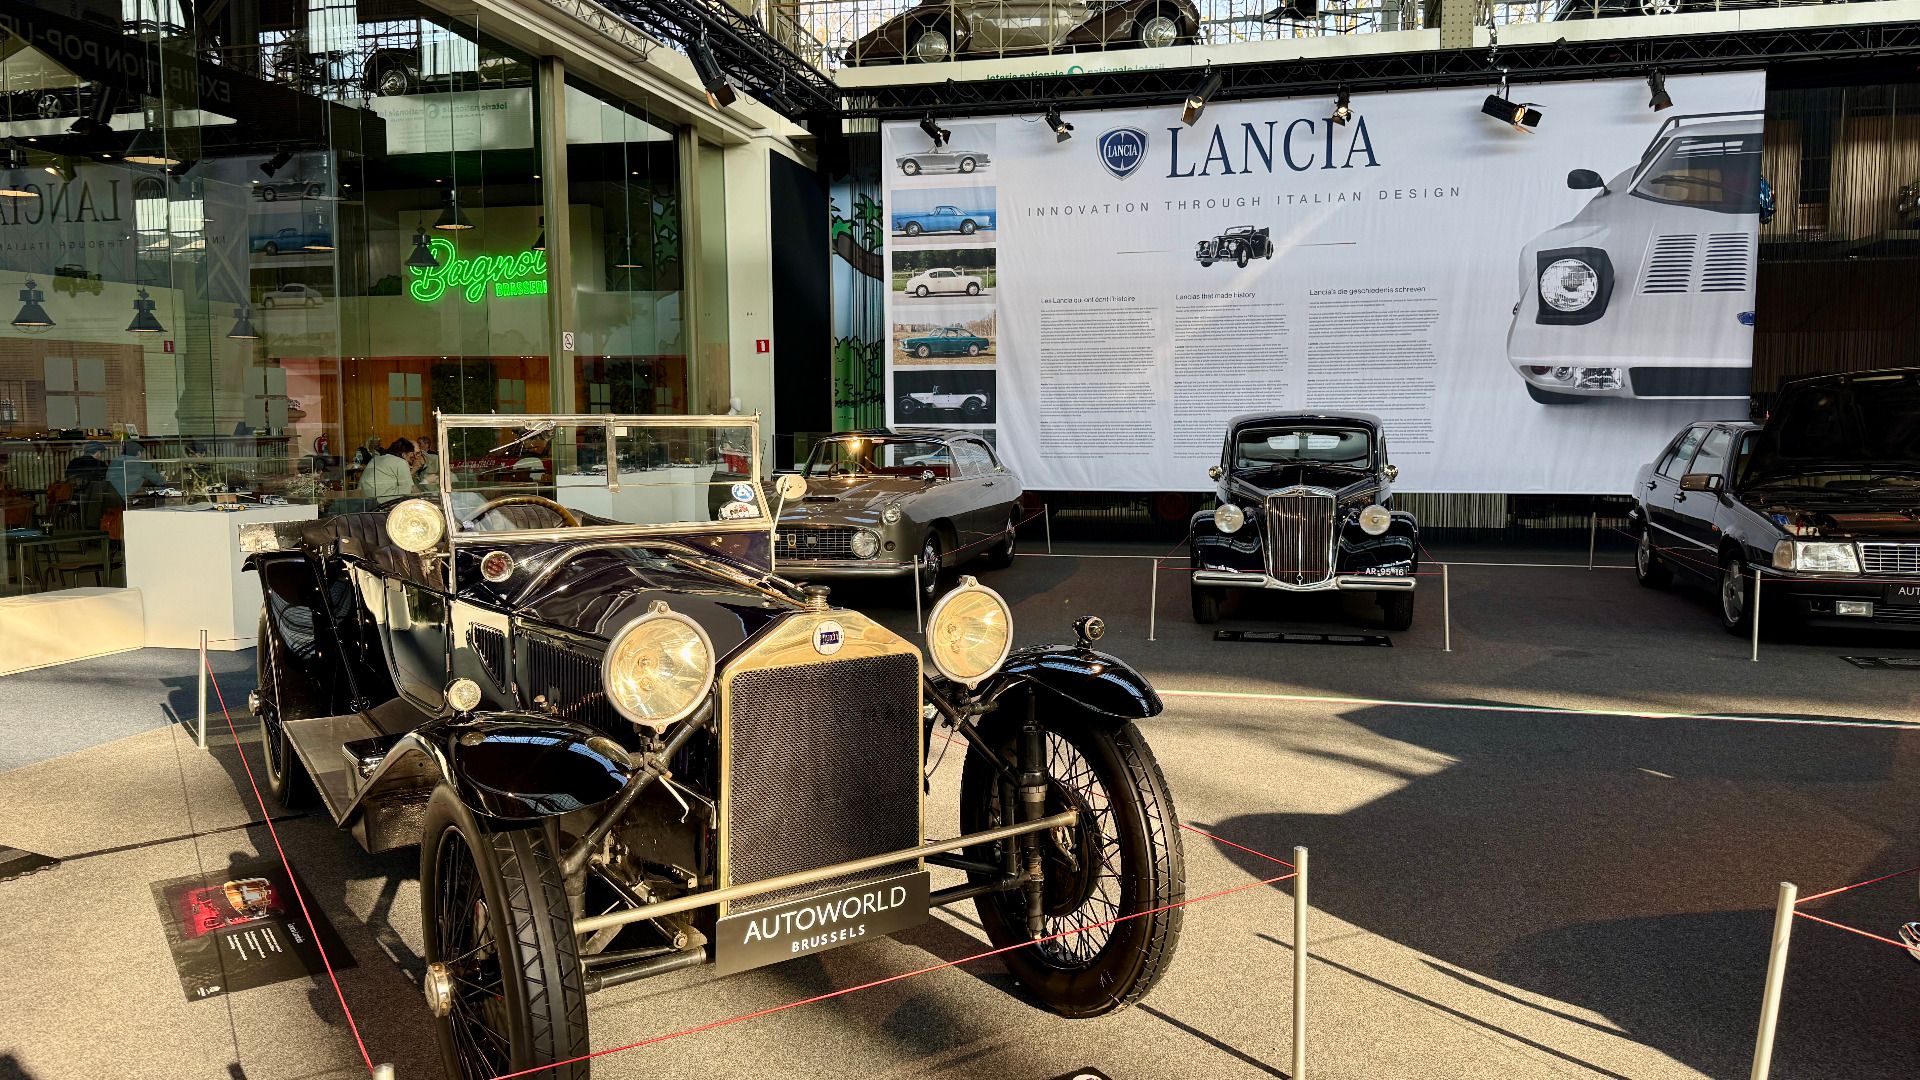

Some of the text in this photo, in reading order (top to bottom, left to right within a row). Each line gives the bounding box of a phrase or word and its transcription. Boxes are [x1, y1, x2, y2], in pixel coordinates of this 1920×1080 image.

[1108, 144, 1138, 158] LANCIA
[1166, 115, 1381, 178] LANCIA
[1028, 187, 1459, 217] INNOVATION THROUGH ITALIAN DESIGN
[1233, 291, 1256, 299] history
[1348, 286, 1394, 296] geschiedenis
[743, 886, 907, 945] AUTOWORLD
[791, 924, 866, 953] BRUSSELS
